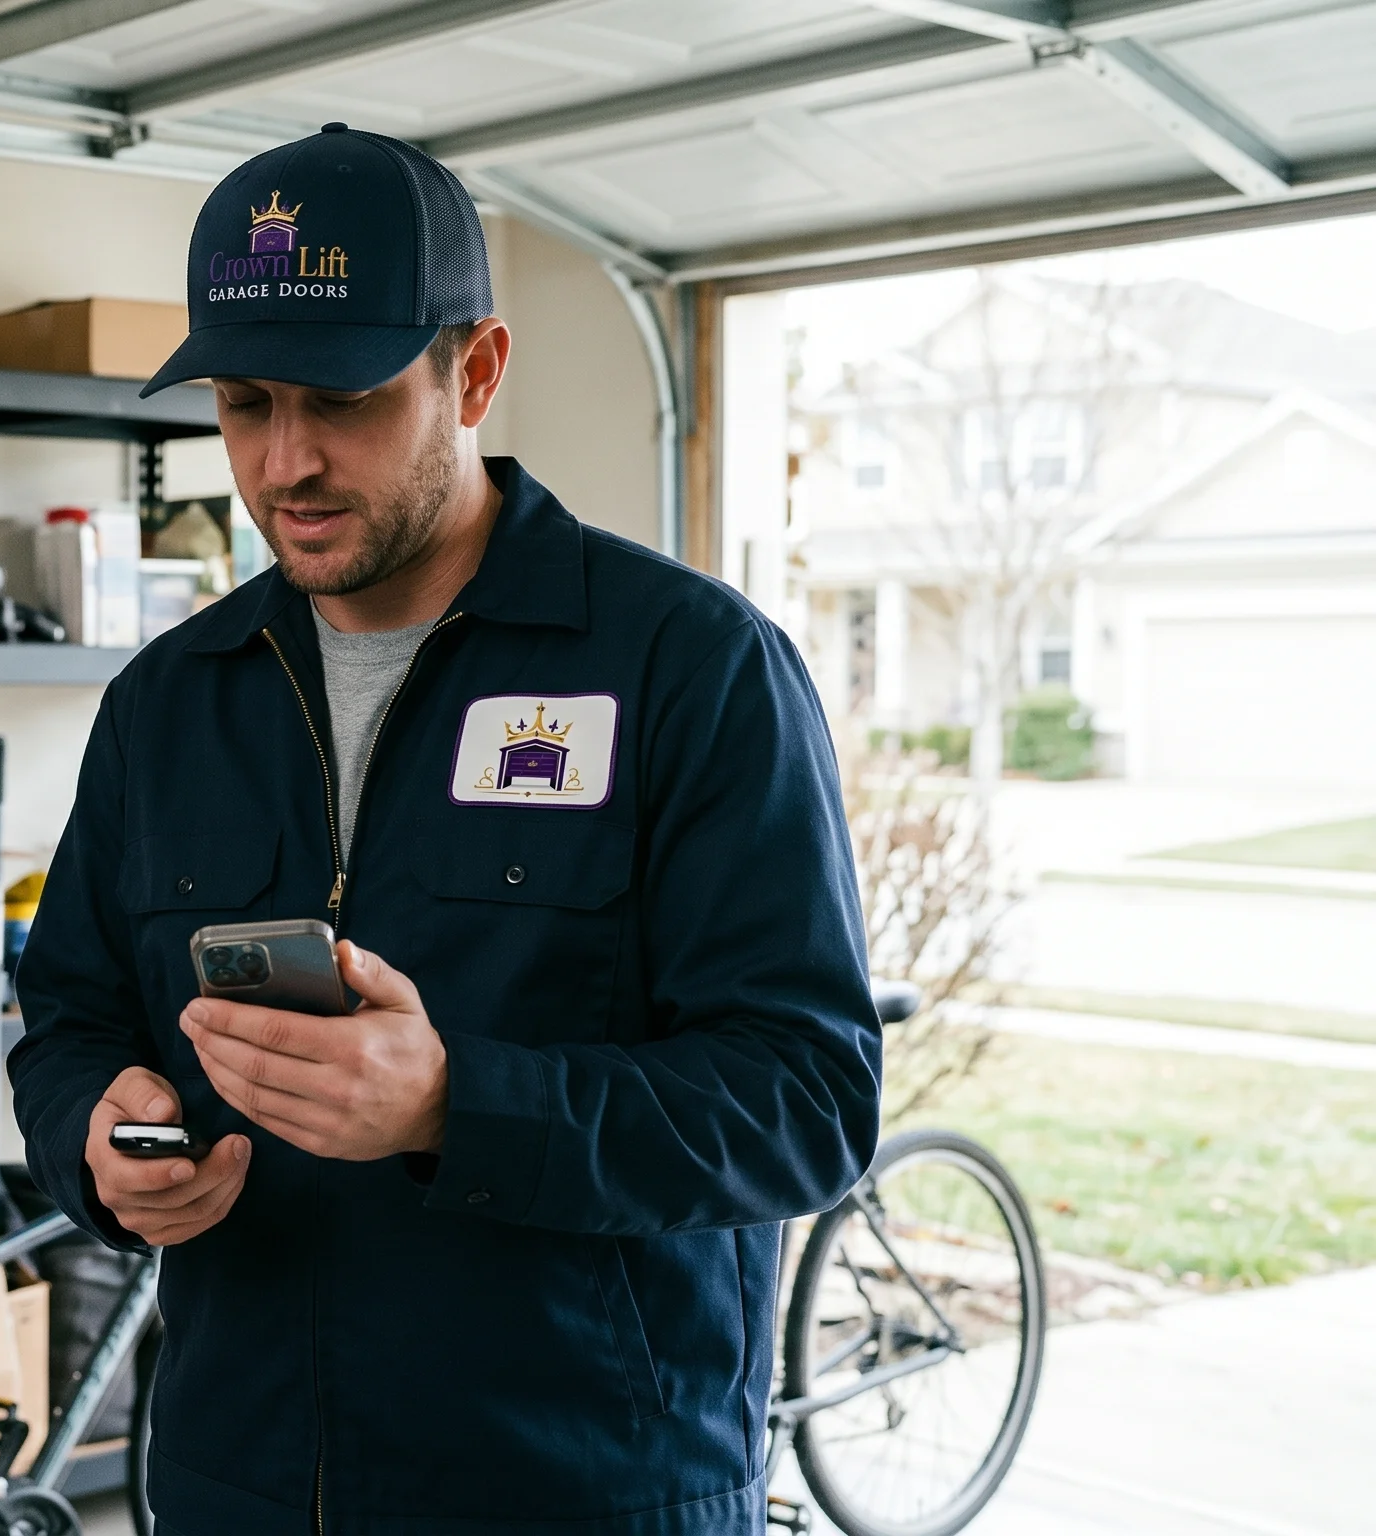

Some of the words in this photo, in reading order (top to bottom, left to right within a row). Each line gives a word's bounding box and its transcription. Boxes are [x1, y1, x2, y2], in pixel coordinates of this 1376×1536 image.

[209, 251, 291, 283] Crown
[297, 246, 349, 278] Lift
[208, 284, 269, 302] GARAGE
[278, 282, 348, 298] DOORS
